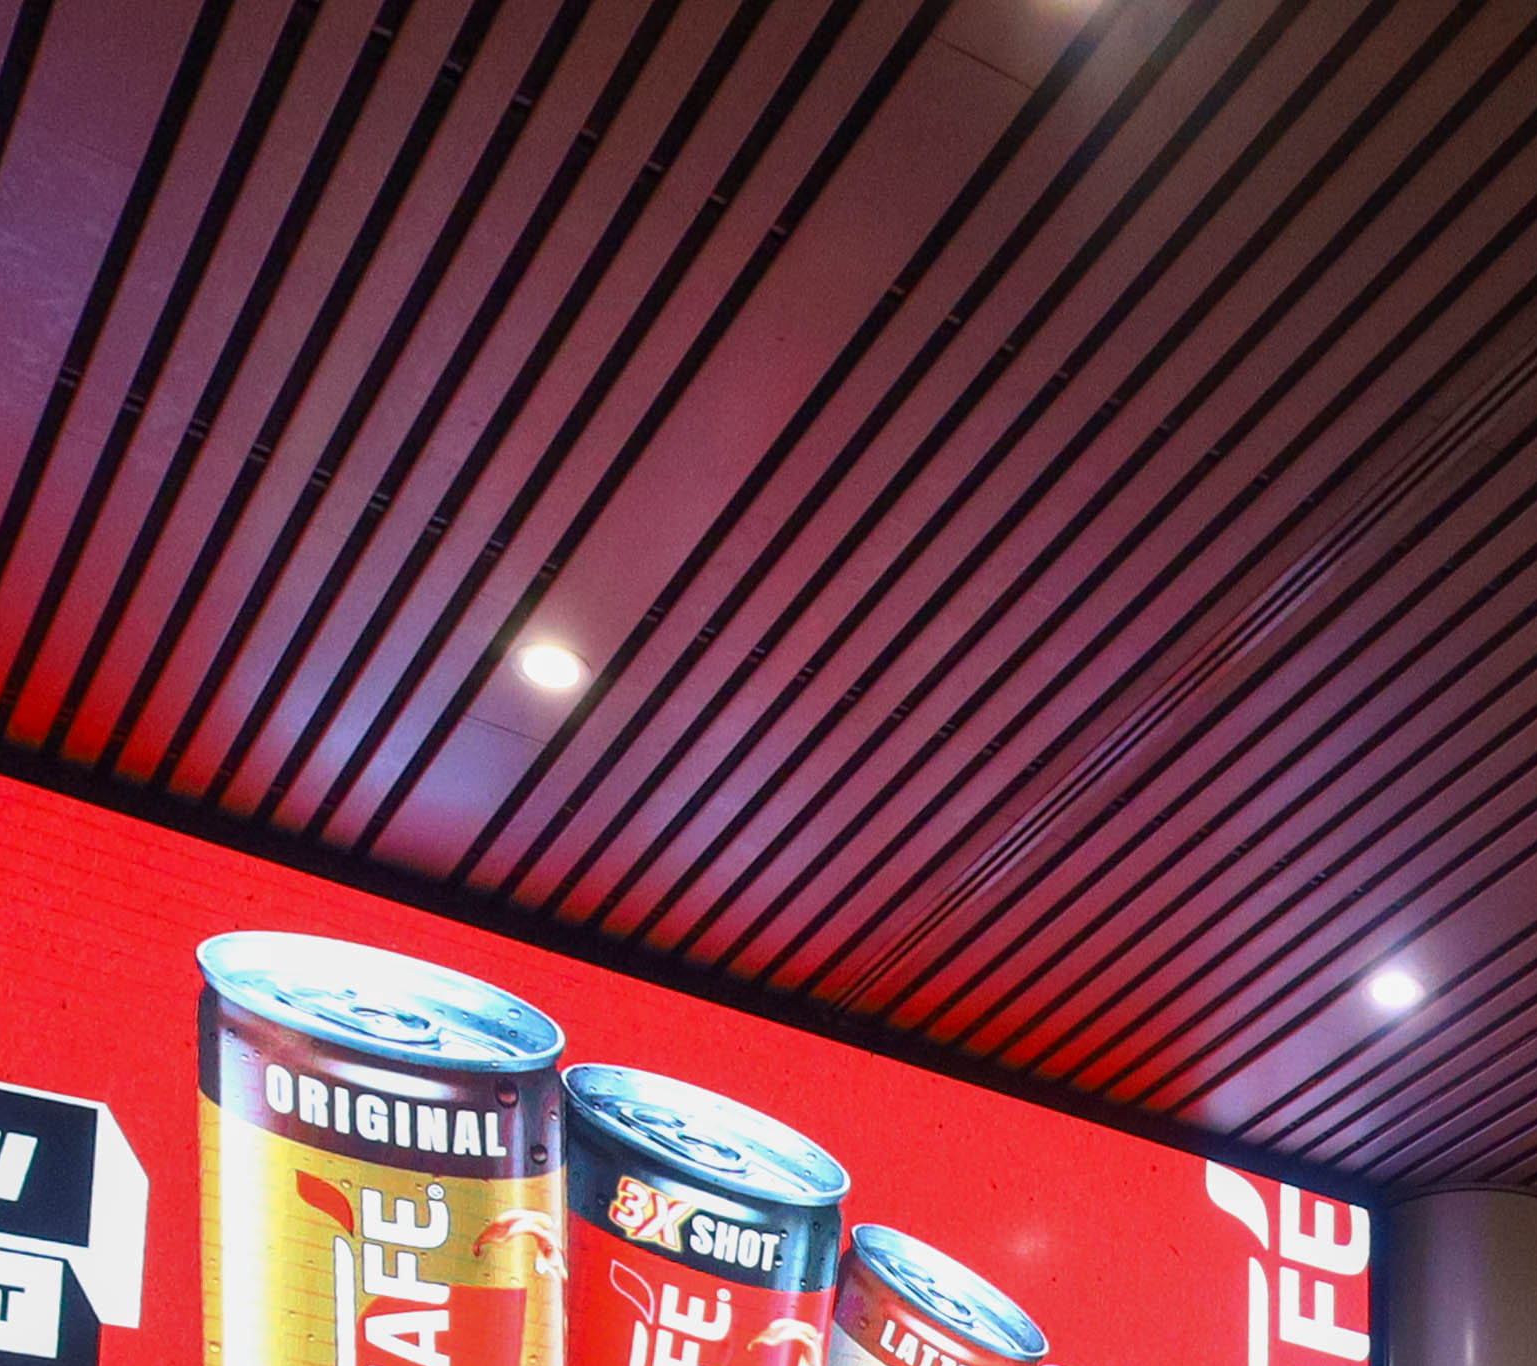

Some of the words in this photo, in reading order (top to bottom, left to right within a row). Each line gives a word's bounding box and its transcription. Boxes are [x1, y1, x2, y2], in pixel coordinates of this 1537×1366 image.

[262, 1063, 508, 1159] ORIGINAL
[613, 1177, 695, 1252] 3X
[690, 1212, 785, 1275] SHOT
